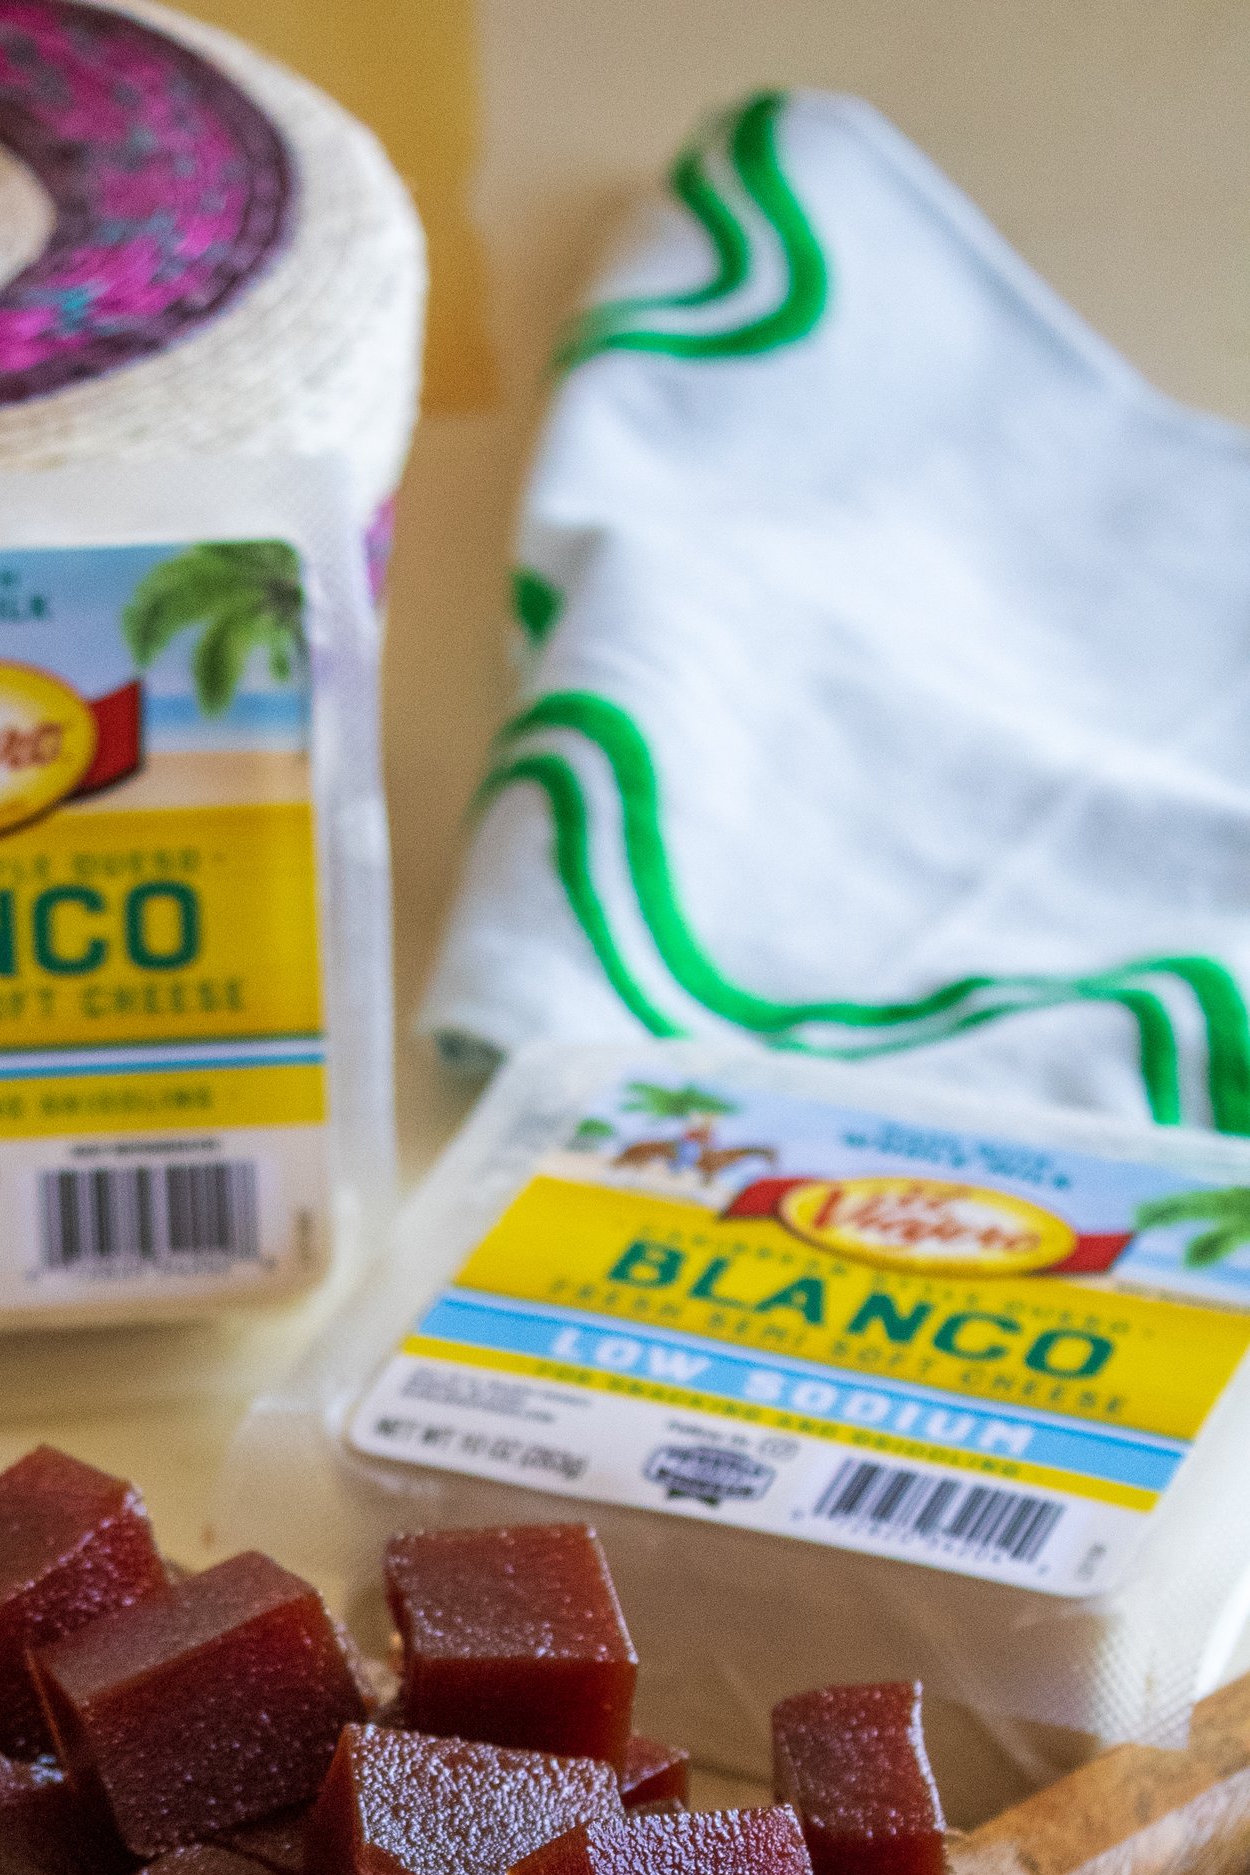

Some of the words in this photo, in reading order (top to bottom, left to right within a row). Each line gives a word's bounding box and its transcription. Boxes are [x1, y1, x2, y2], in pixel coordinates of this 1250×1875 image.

[80, 978, 247, 1020] CHEESE
[548, 1276, 683, 1319] FRESH
[706, 1310, 807, 1348] SEMI
[829, 1339, 937, 1375] SOFT
[959, 1367, 1127, 1416] CHEESE
[606, 1238, 1116, 1381] BLANCO
[552, 1327, 713, 1383] LOW
[743, 1368, 1036, 1457] SODIUM
